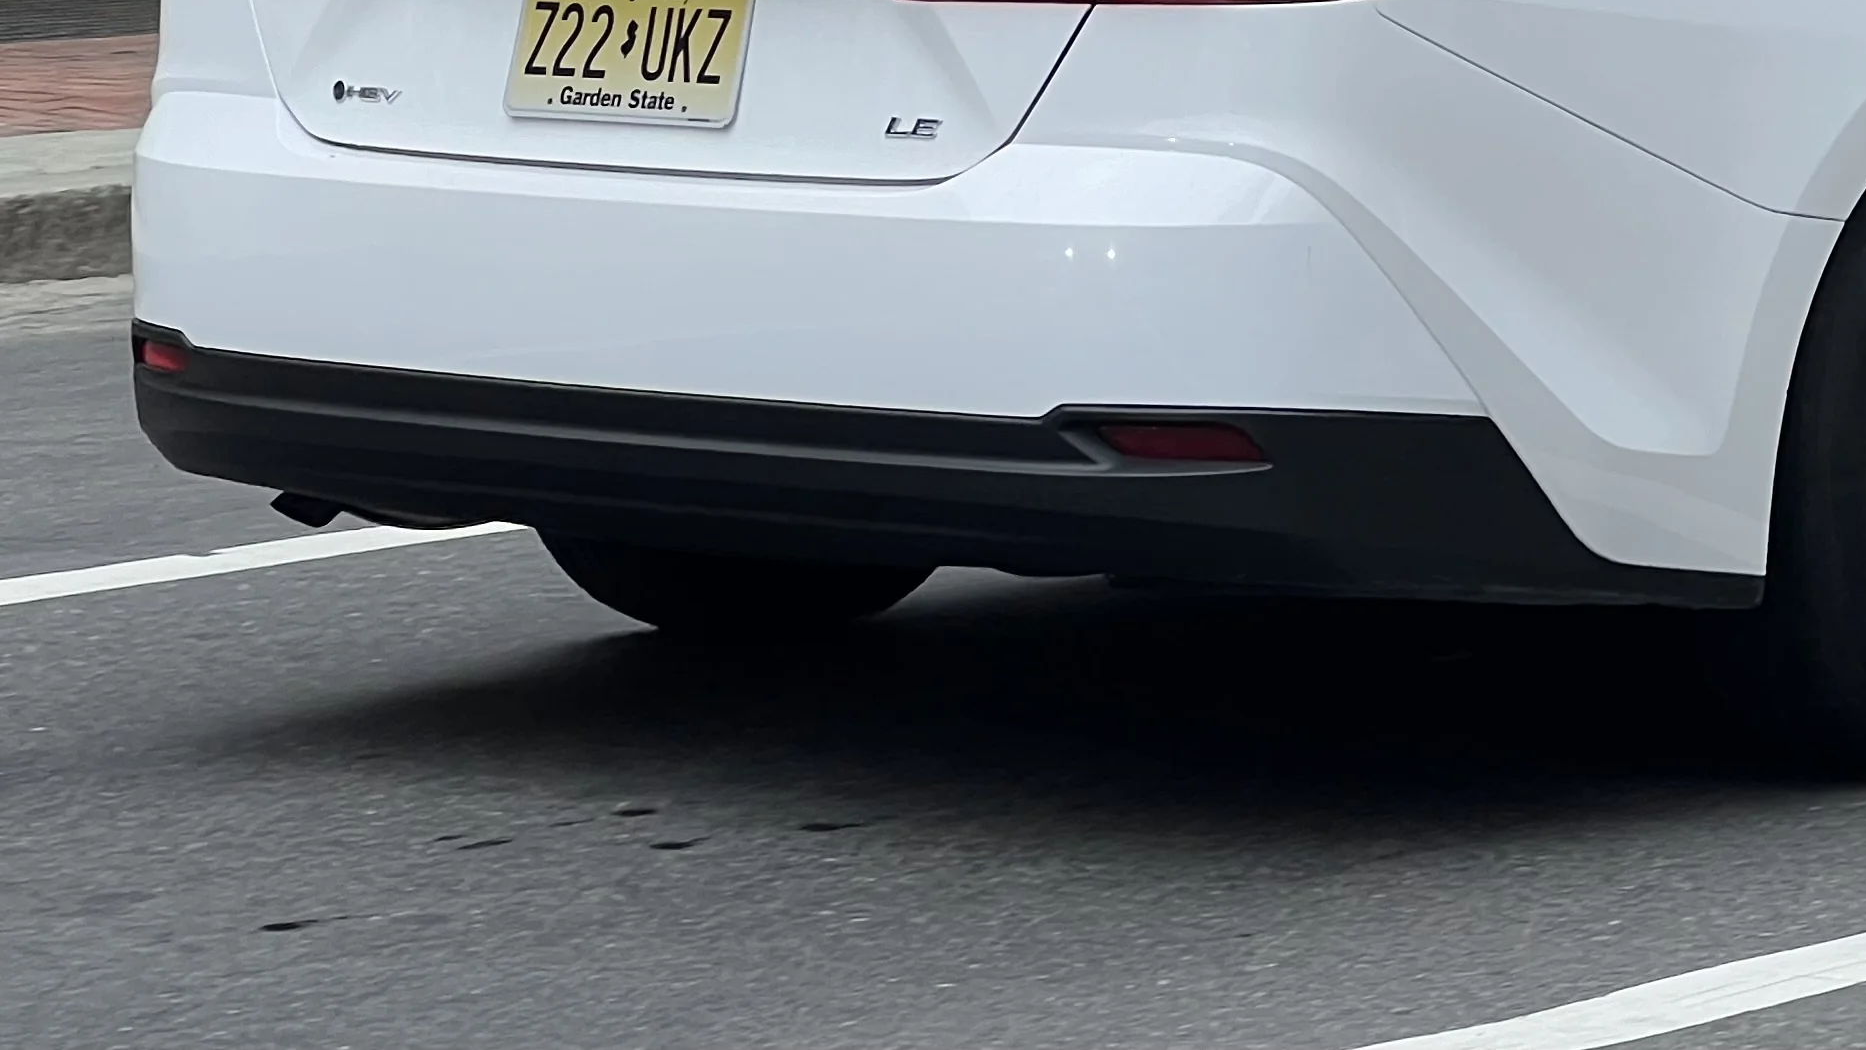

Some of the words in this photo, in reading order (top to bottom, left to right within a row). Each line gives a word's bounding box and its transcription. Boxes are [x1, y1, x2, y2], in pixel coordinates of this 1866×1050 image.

[524, 1, 615, 79] Z22
[641, 6, 733, 85] UKZ
[560, 86, 622, 108] Garden
[628, 89, 675, 111] State
[884, 116, 944, 139] LE
